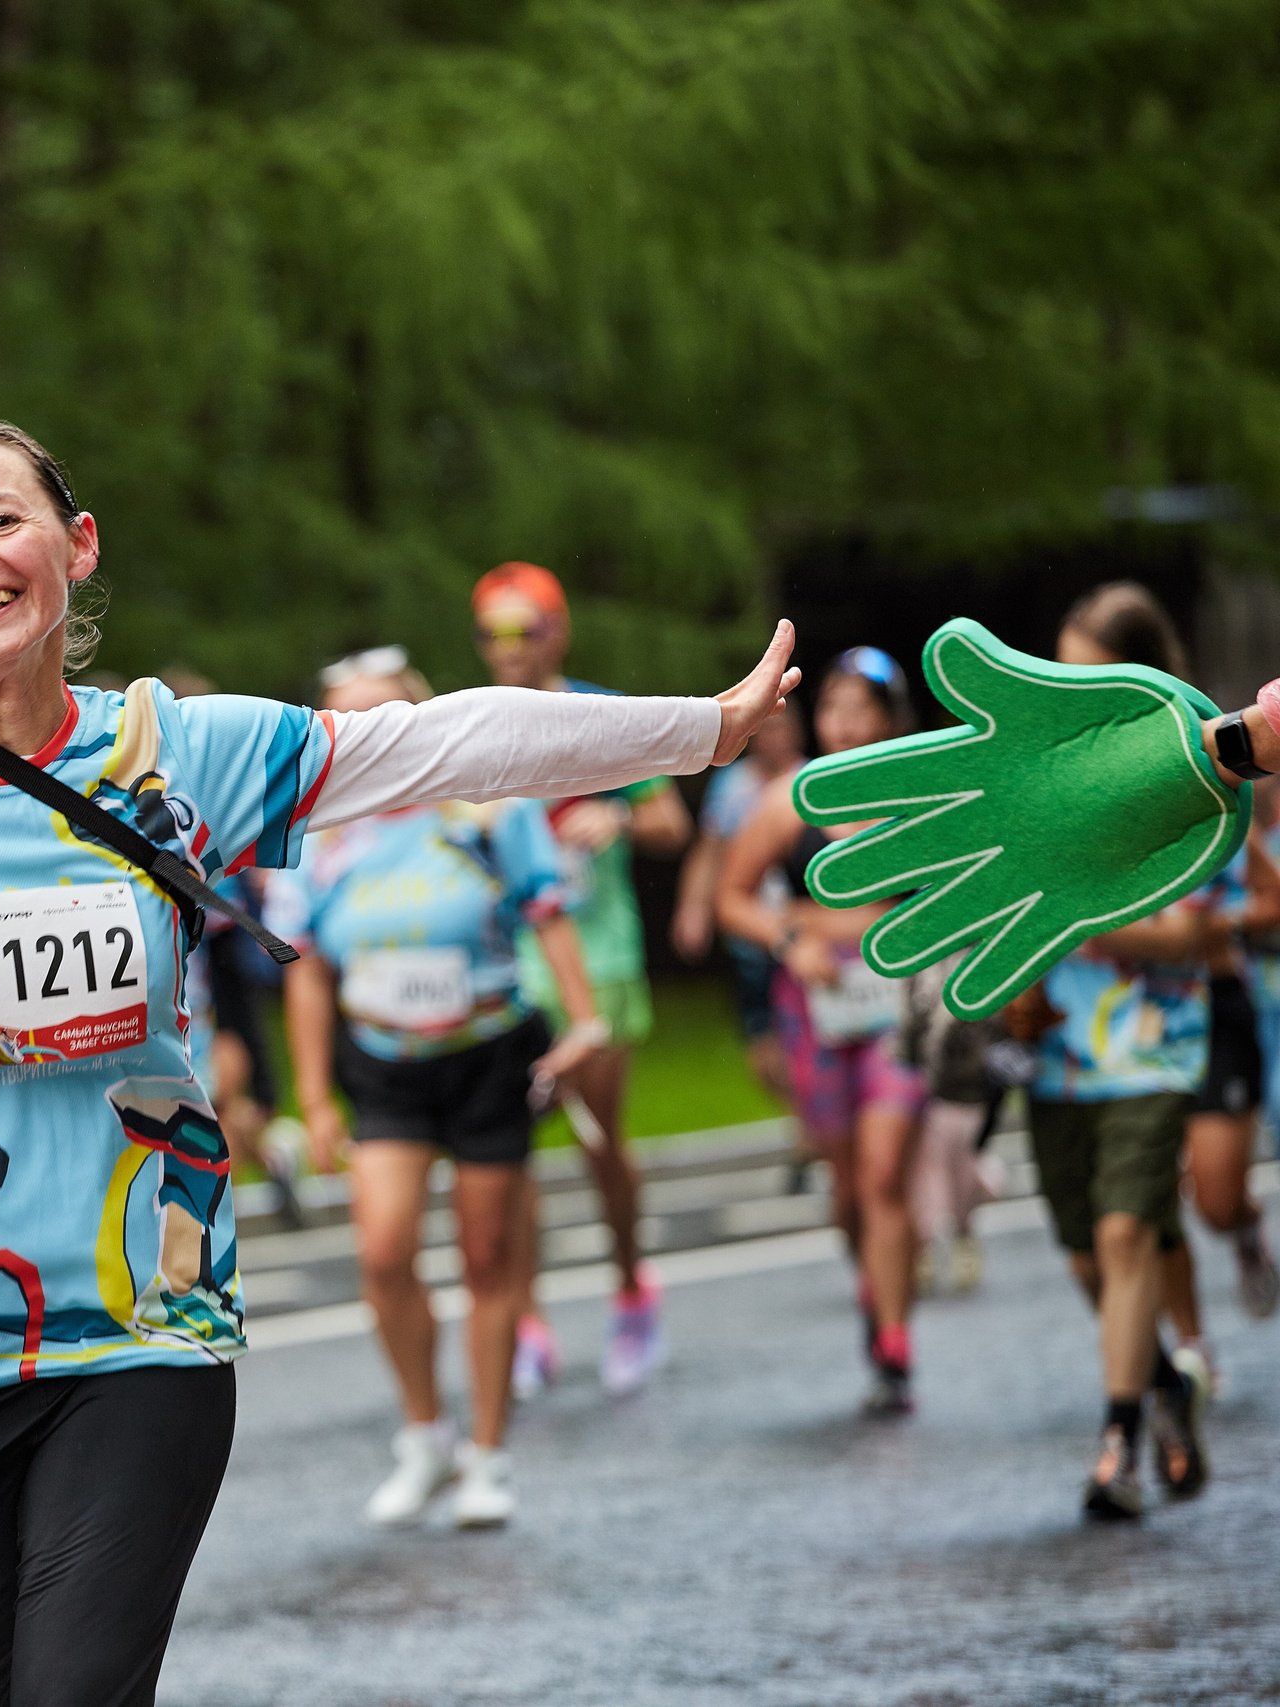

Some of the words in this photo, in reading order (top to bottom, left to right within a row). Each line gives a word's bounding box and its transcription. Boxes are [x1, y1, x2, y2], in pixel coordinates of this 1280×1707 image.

[2, 926, 138, 1002] 1212
[53, 1024, 91, 1041] САМЫЙ
[94, 1015, 139, 1035] ВКУСНЫЙ
[69, 1035, 100, 1051] ЗАБЕГ
[102, 1028, 139, 1045] СТРАНЫ
